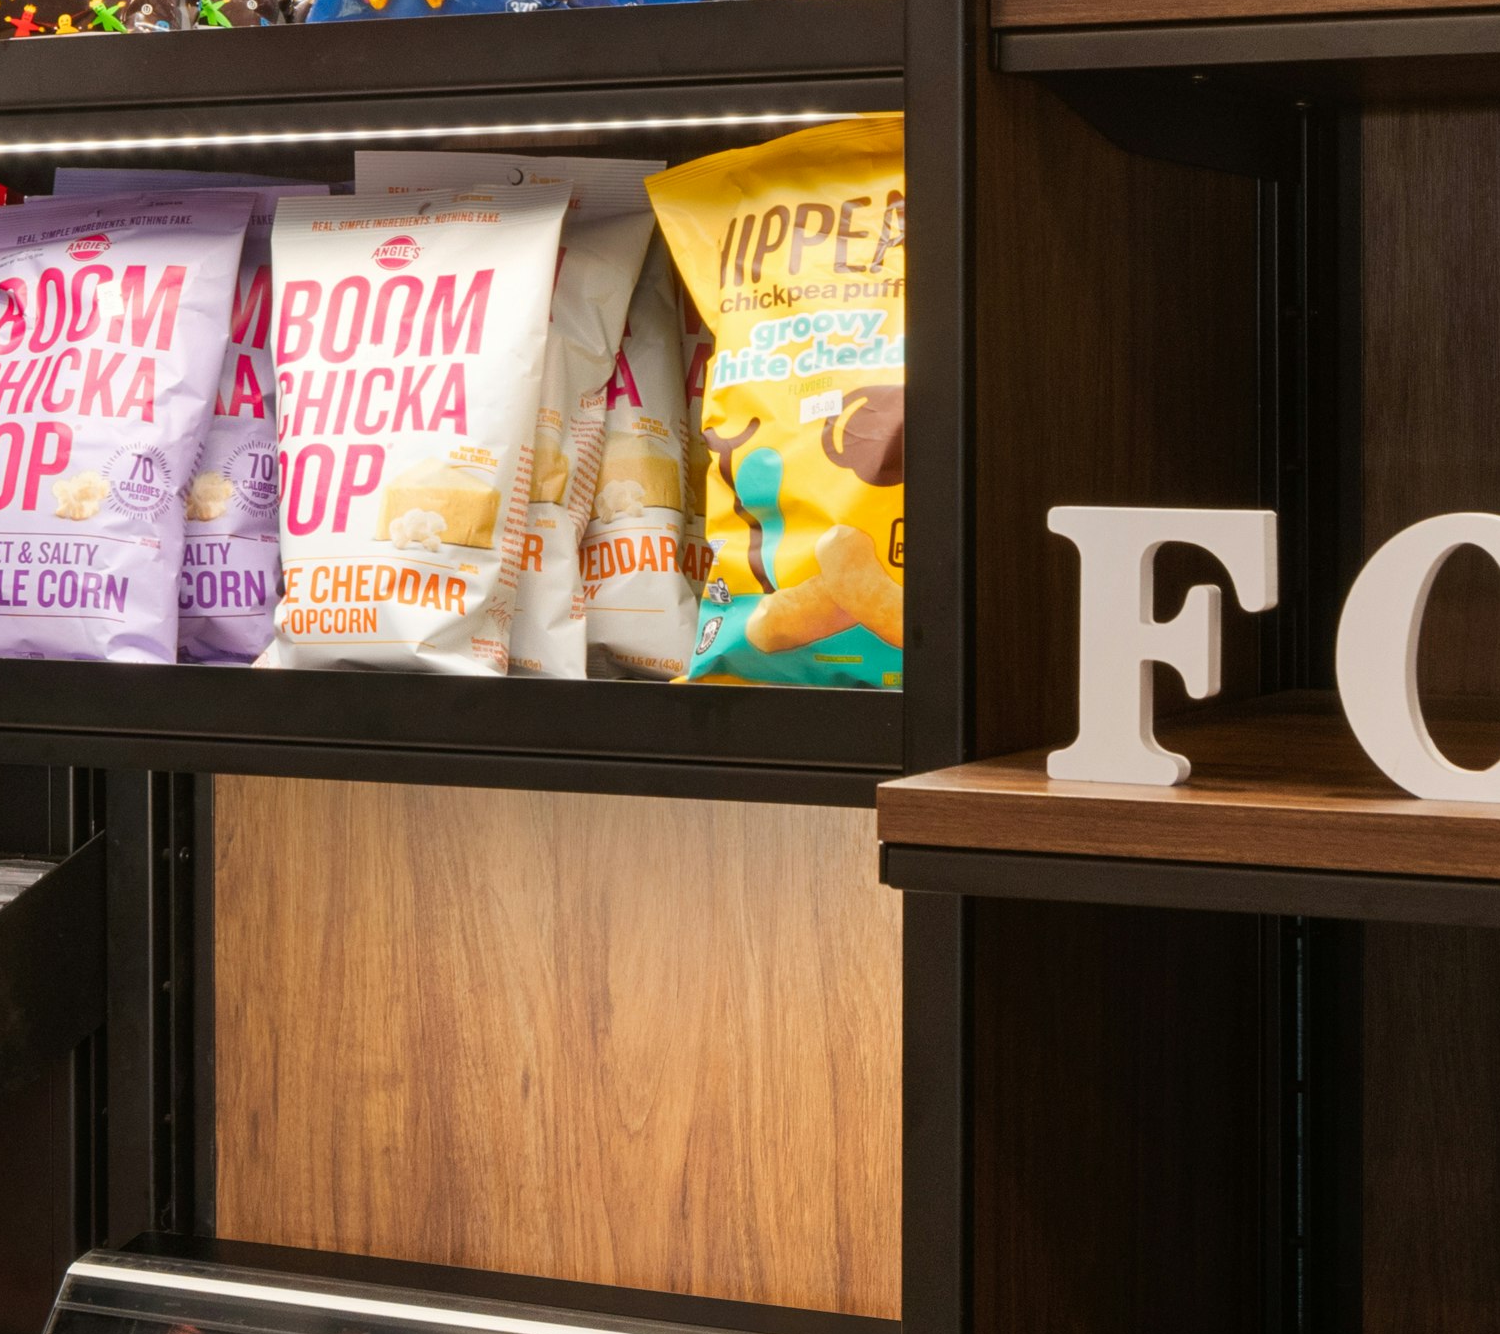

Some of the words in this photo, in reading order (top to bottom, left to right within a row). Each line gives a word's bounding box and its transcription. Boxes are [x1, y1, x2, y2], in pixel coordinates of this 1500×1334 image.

[40, 228, 70, 241] SIMPLE
[129, 217, 167, 227] NOTHING
[66, 238, 112, 254] ANGIE'S
[720, 282, 837, 314] chickpea
[277, 268, 495, 366] BOOM
[755, 312, 883, 350] groovy
[280, 362, 467, 435] CHICKA
[129, 453, 154, 484] 70
[119, 480, 160, 498] CALORIES
[18, 542, 32, 564] &
[40, 544, 99, 566] SALTY
[48, 570, 128, 614] CORN
[310, 565, 466, 616] CHEDDAR
[283, 606, 378, 635] POPCORN
